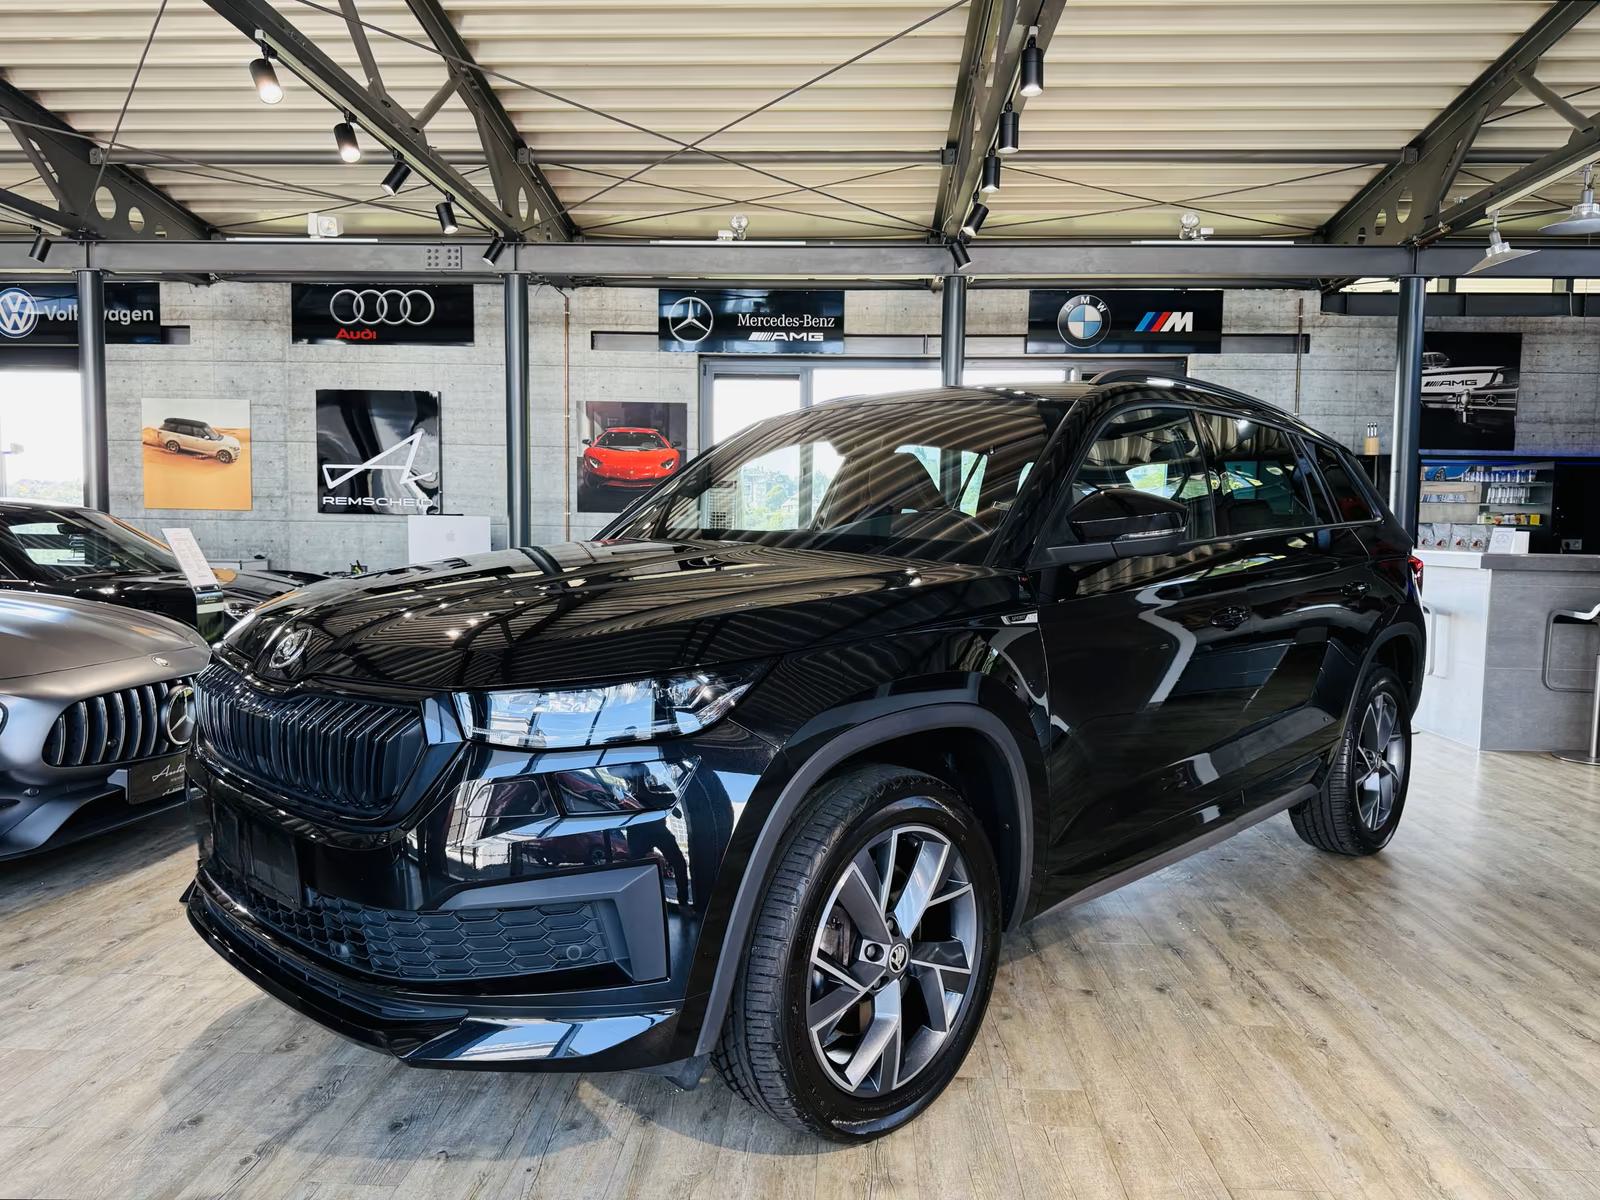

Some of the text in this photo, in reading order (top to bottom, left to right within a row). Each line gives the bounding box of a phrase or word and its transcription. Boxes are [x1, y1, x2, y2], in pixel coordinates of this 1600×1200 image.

[1064, 295, 1107, 313] BMW
[44, 304, 154, 326] Volagen
[737, 313, 836, 328] Mercedes-Benz
[335, 328, 377, 340] Audi
[1439, 379, 1478, 387] AMG
[322, 496, 434, 507] REMSCHEID
